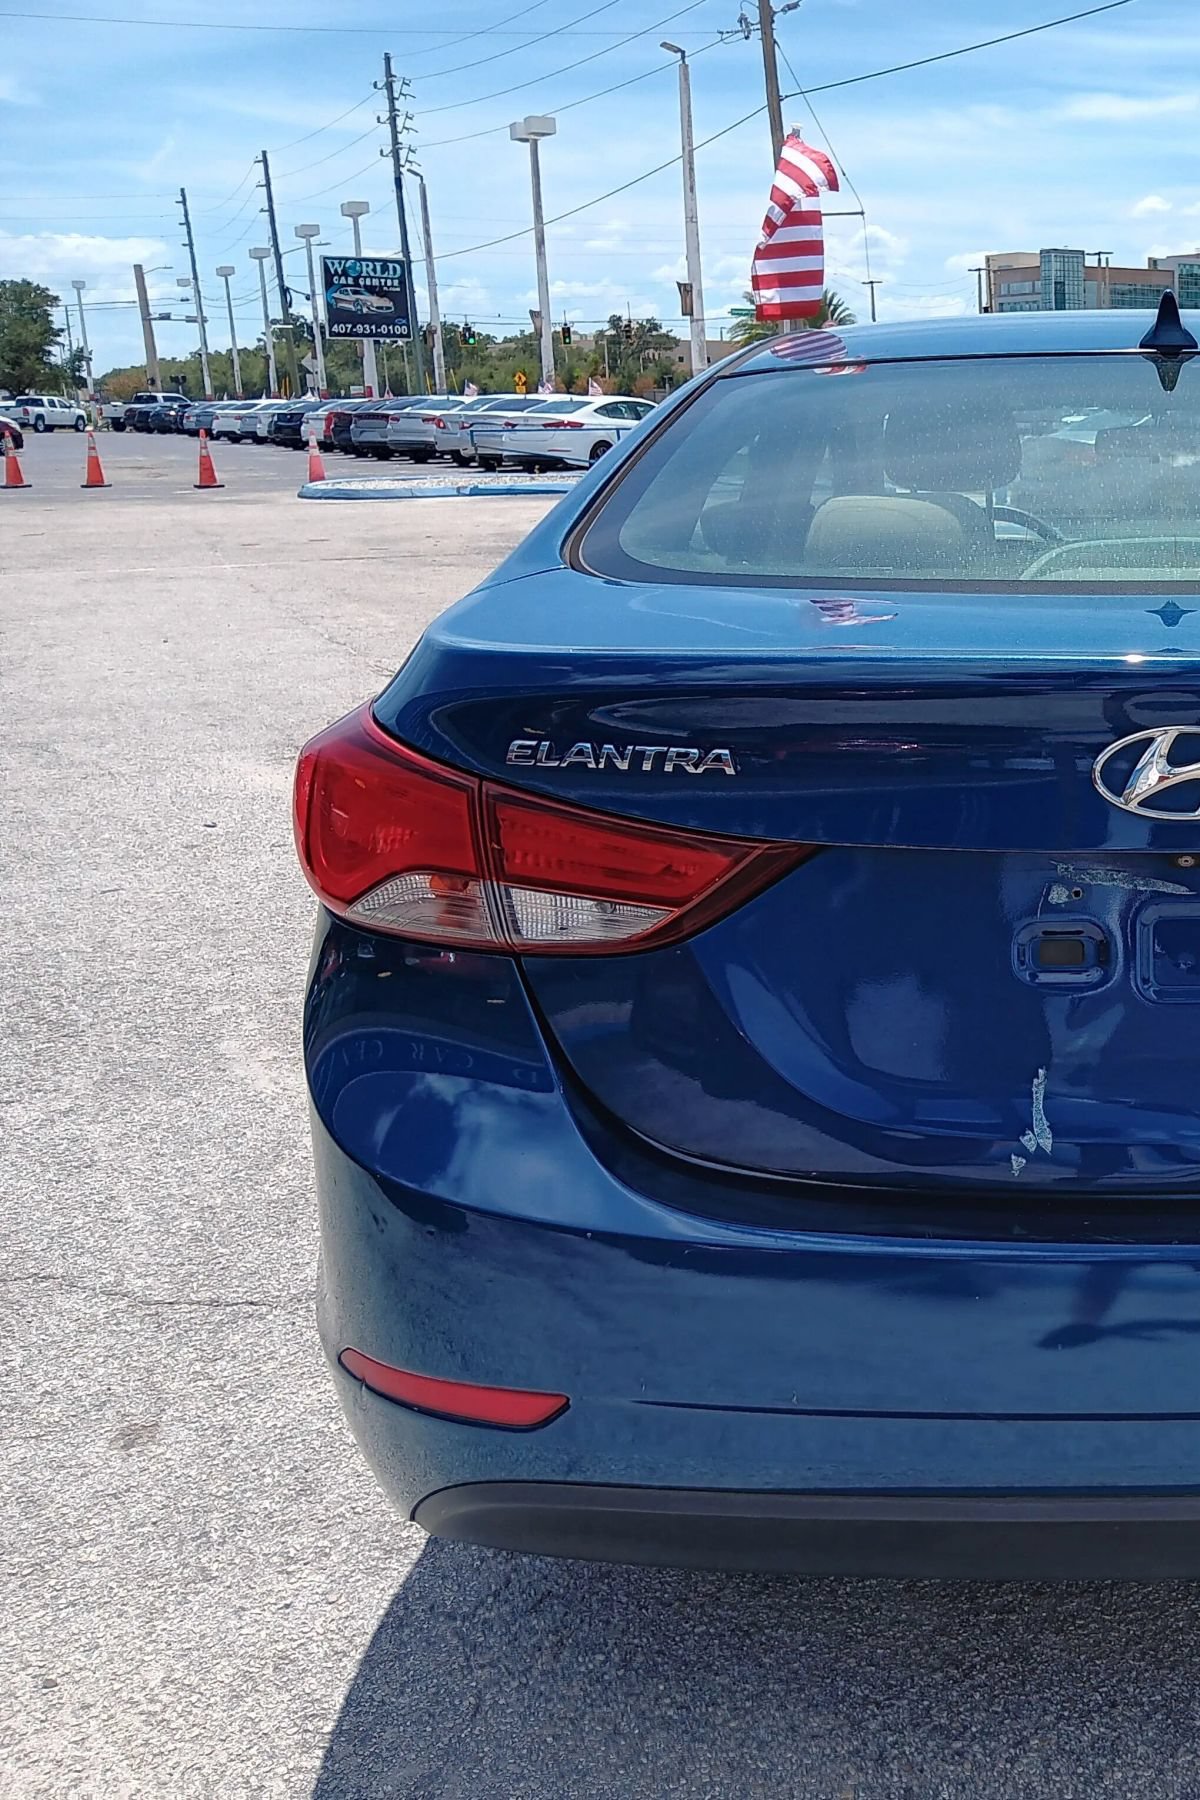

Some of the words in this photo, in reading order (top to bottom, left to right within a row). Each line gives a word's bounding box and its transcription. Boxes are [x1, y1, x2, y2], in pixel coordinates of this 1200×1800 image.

[325, 260, 402, 278] WORLD
[333, 276, 354, 285] CAR
[359, 278, 400, 287] CENTER
[331, 323, 408, 334] 407-931-0100
[506, 739, 736, 775] ELANTRA
